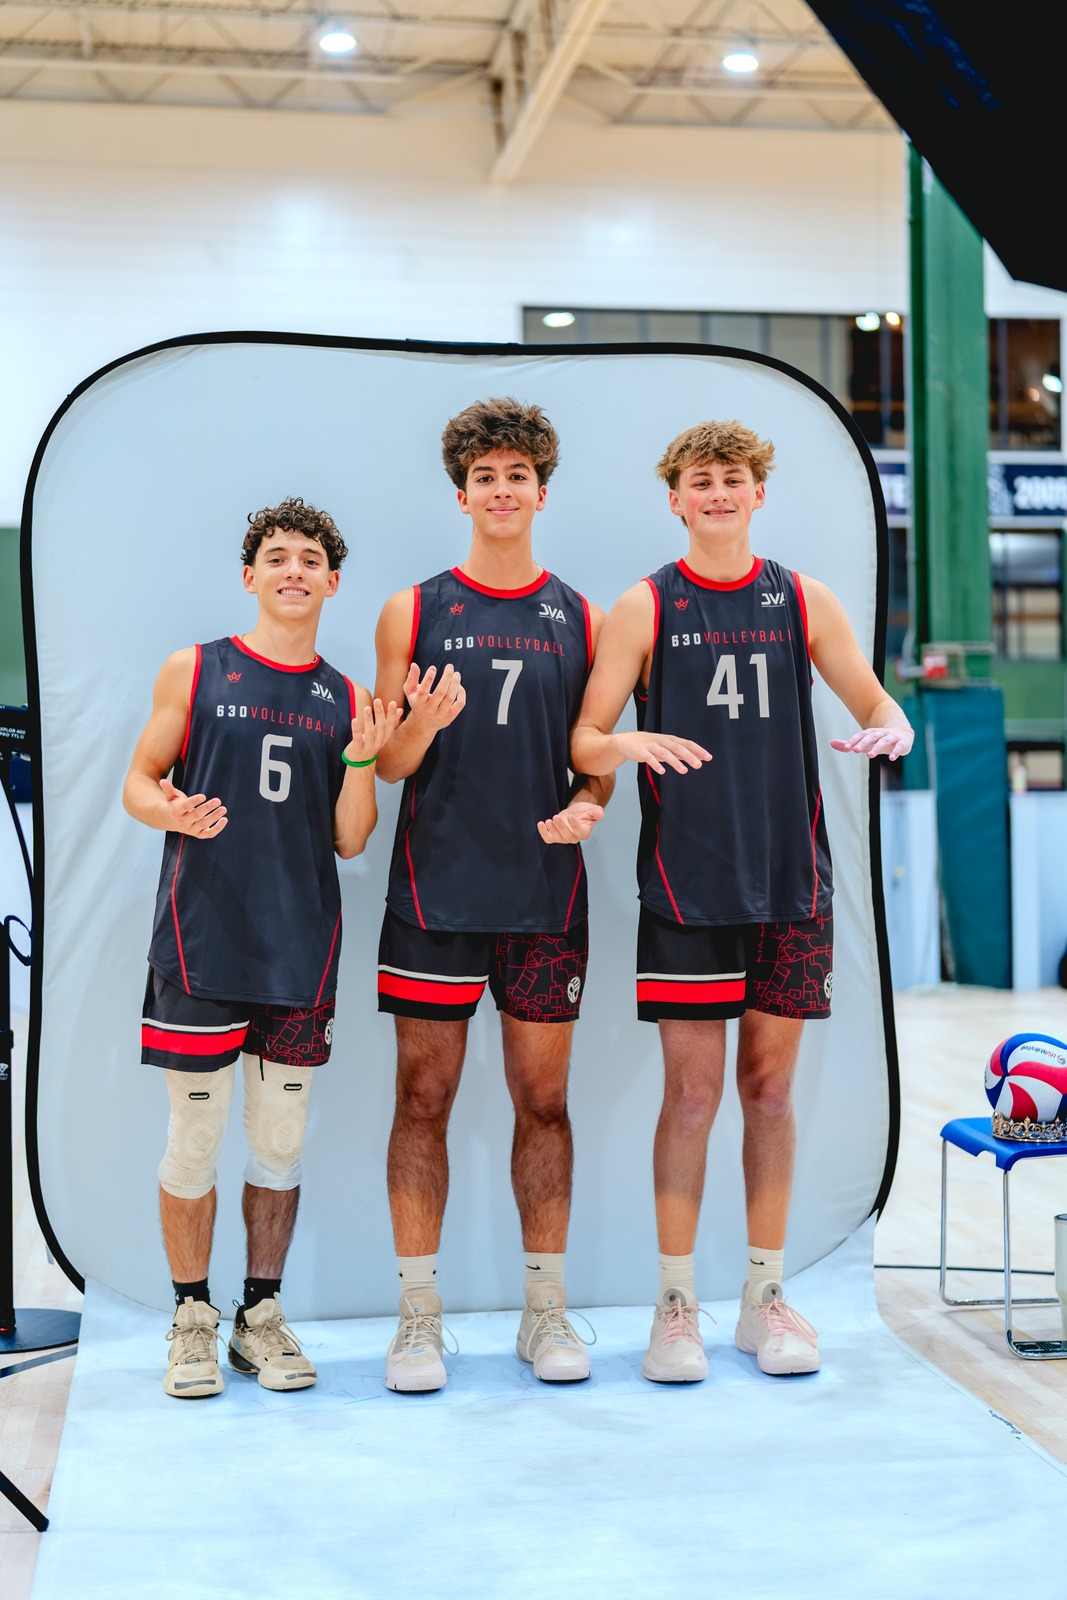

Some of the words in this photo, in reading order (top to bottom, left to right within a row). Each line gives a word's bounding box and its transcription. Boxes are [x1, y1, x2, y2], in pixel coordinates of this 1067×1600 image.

[539, 603, 566, 622] JVA
[491, 658, 523, 725] 7
[706, 653, 770, 719] 41
[259, 733, 293, 803] 6
